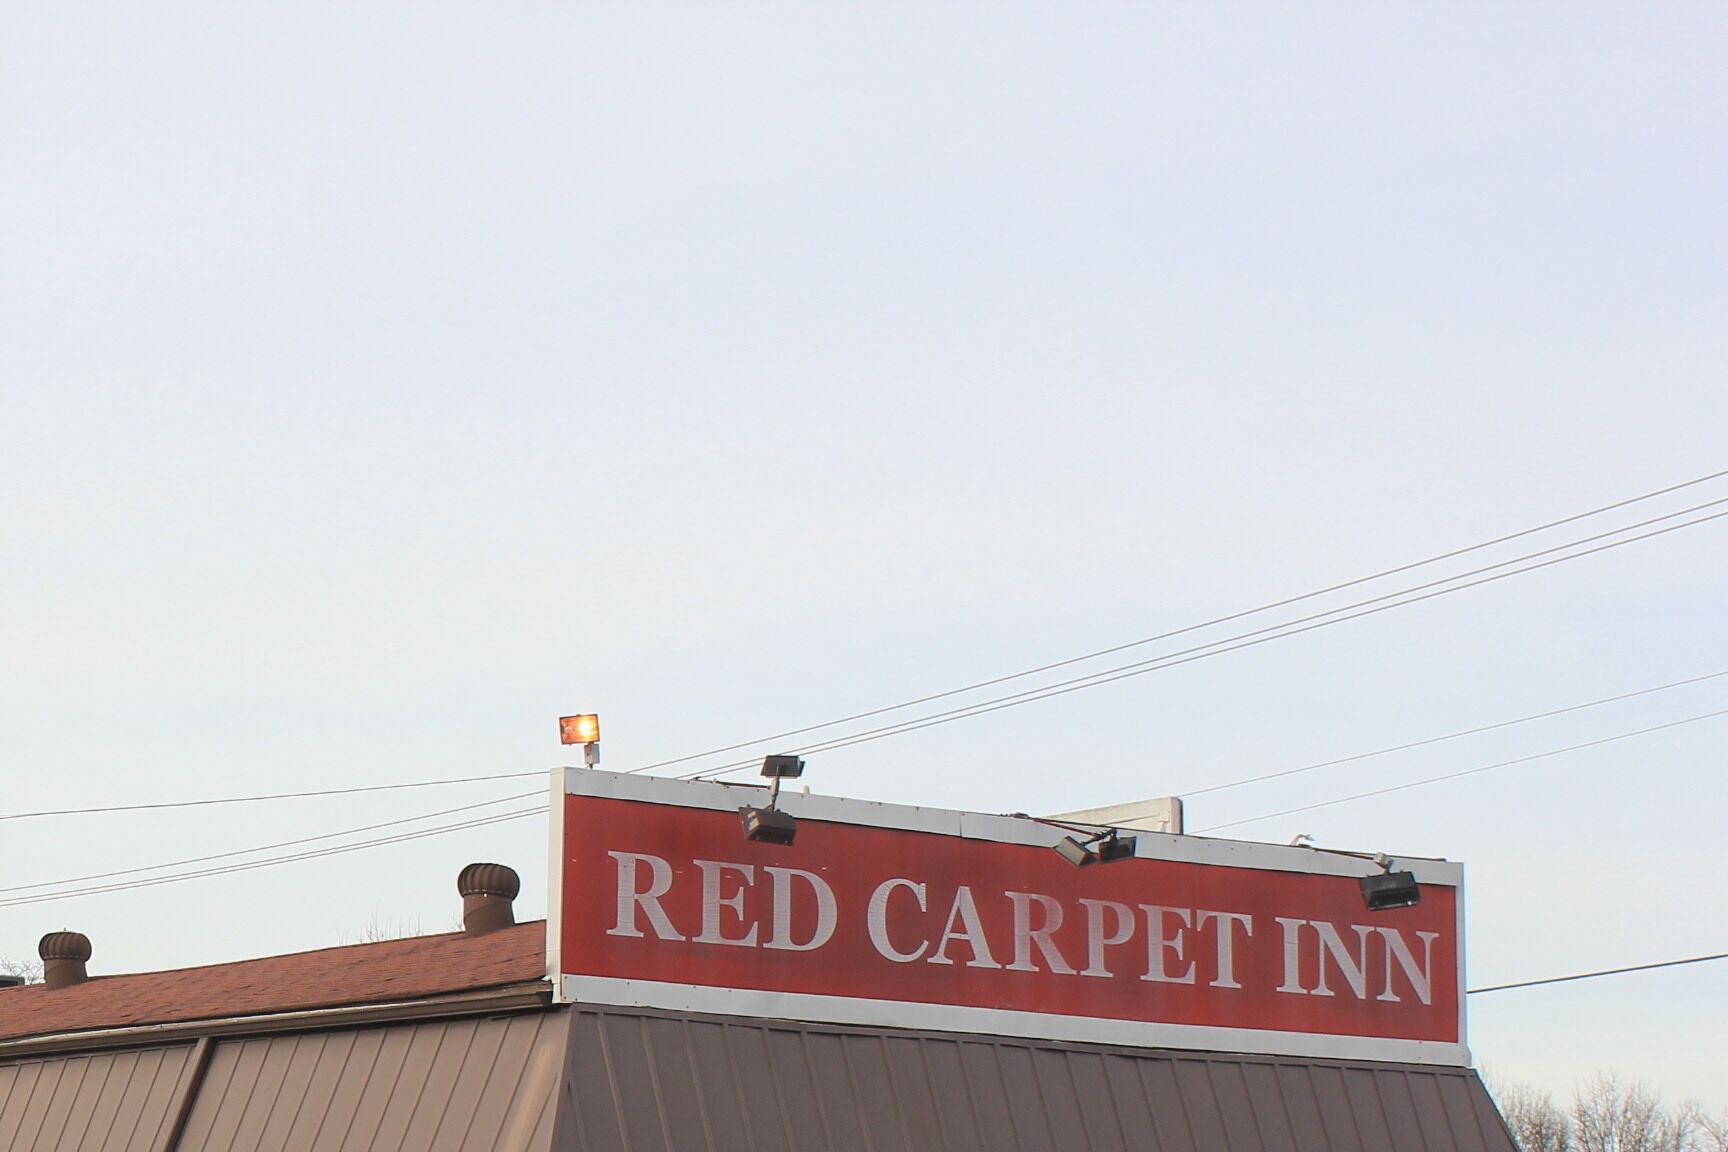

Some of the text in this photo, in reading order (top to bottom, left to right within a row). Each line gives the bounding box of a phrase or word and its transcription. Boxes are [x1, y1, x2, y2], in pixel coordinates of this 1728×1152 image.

[606, 850, 1440, 1005] RED CARPET INN
